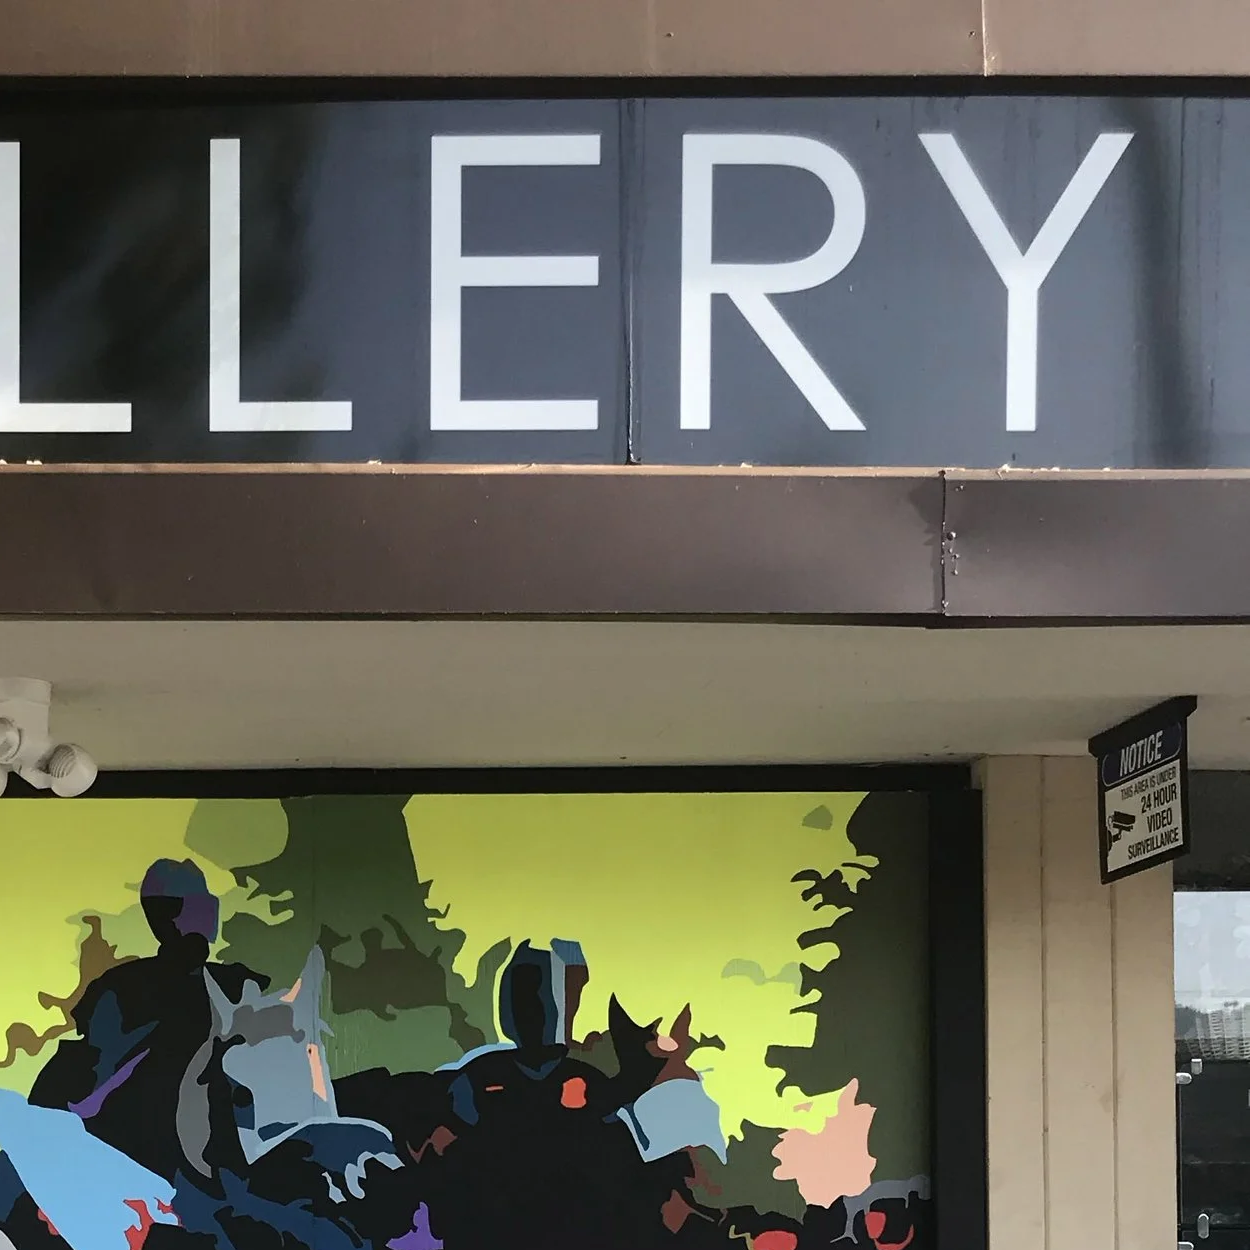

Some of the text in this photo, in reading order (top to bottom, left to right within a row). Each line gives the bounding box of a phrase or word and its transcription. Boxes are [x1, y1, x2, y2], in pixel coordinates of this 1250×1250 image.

[1120, 730, 1163, 777] NOTICE
[1121, 785, 1134, 800] THIS
[1134, 778, 1148, 796] AREA
[1156, 766, 1176, 785] UNDER
[1141, 783, 1177, 813] 24 HOUR
[1147, 808, 1172, 833] VIDEO
[1128, 827, 1179, 860] SURVEILLANCE
